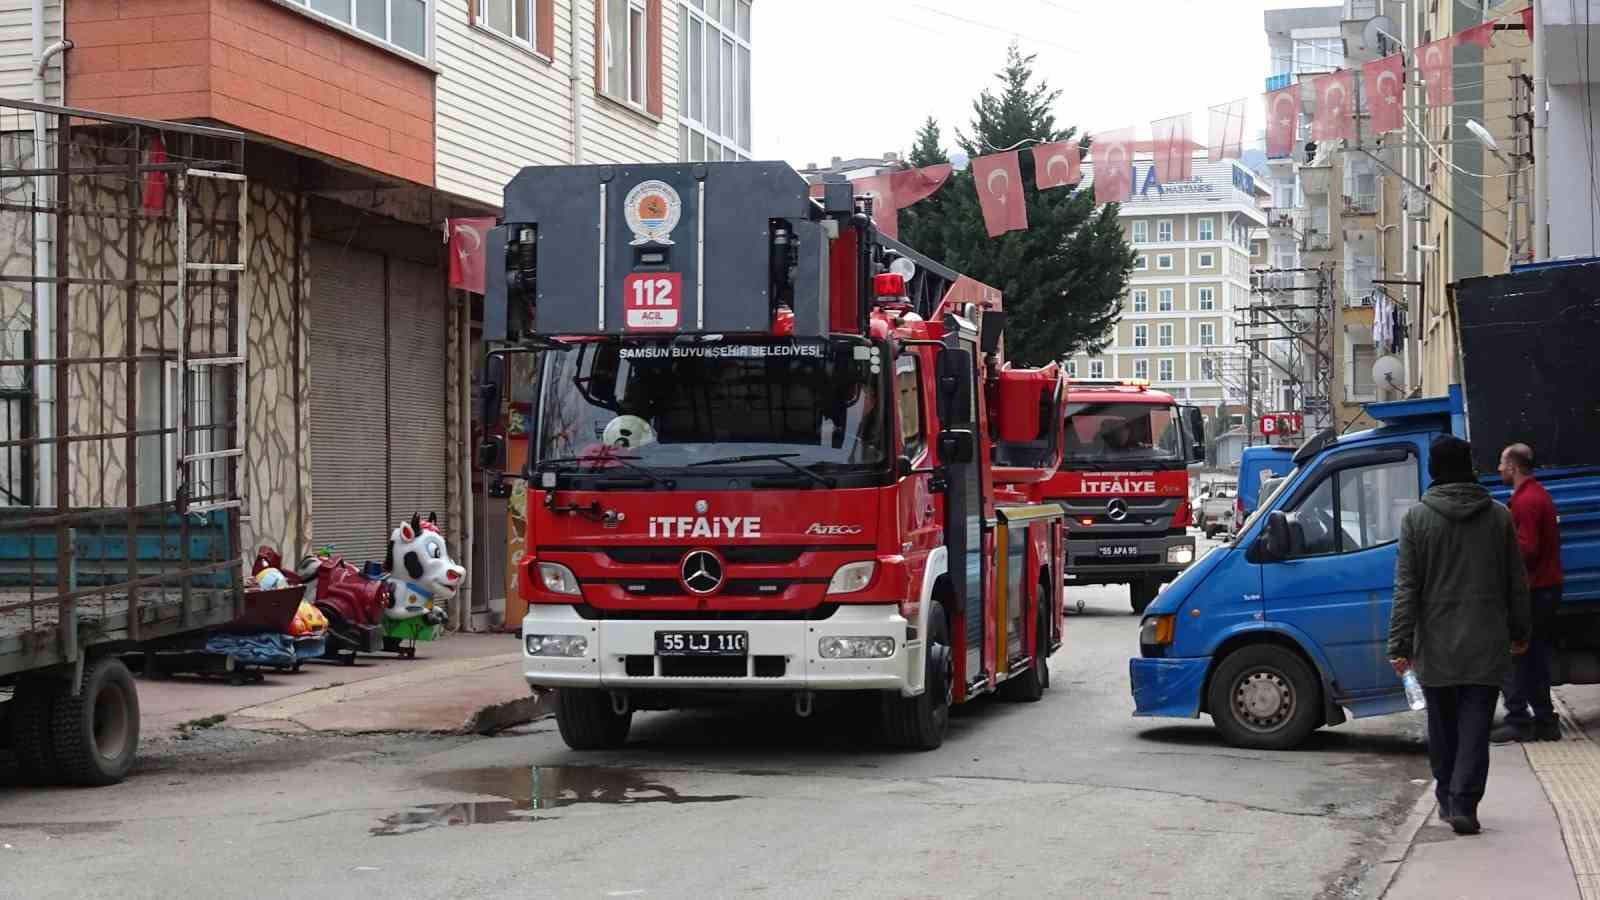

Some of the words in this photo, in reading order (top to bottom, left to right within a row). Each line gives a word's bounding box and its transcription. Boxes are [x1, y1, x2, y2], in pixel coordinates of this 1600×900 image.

[633, 279, 673, 306] 112
[619, 348, 669, 359] SAMSUN
[663, 634, 684, 650] 55
[689, 634, 710, 650] LJ
